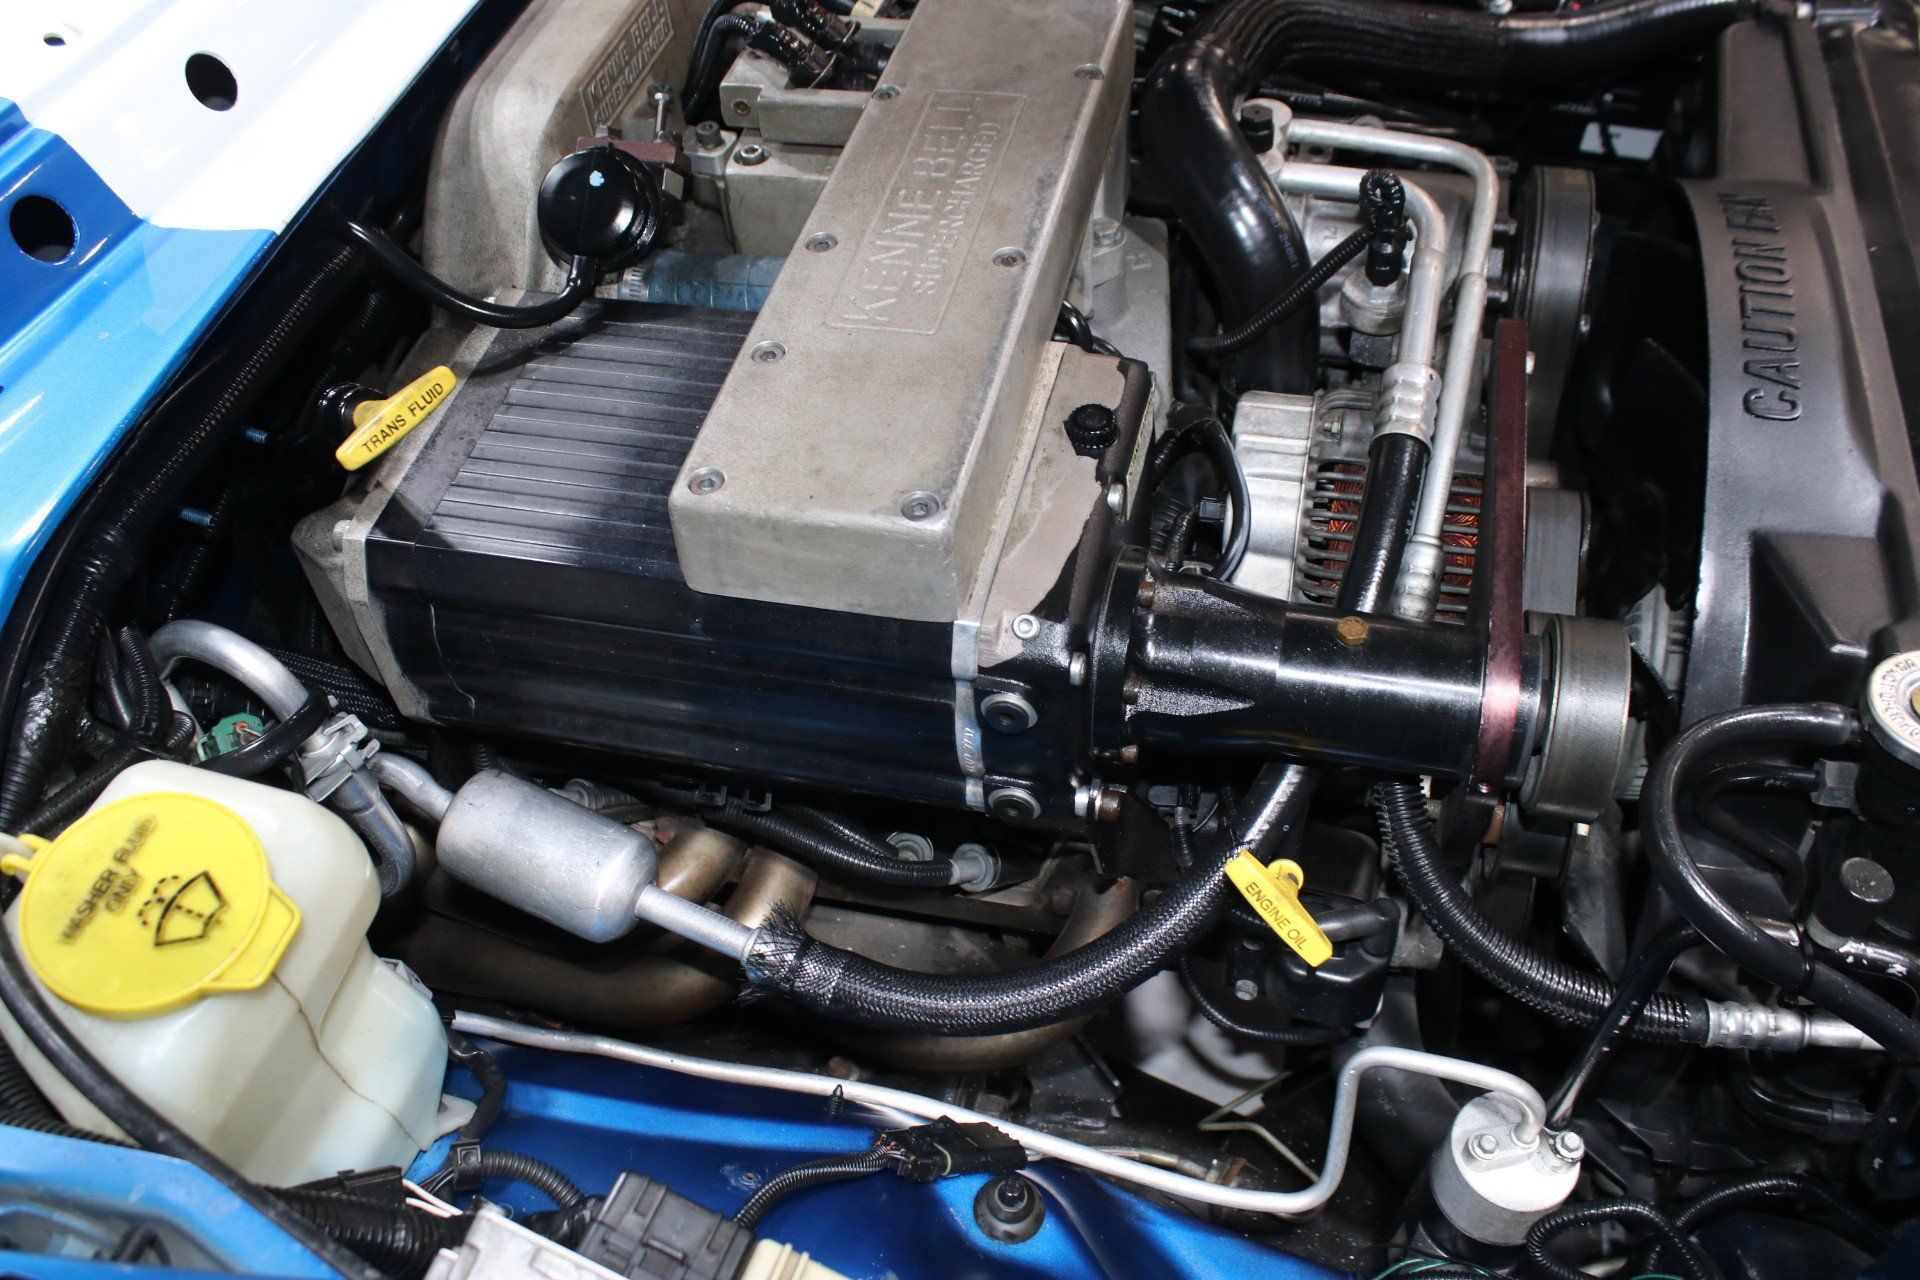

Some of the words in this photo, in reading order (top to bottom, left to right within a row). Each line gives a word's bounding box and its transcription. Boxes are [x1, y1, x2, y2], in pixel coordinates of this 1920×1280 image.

[842, 190, 940, 323] KENNE
[914, 97, 980, 178] BELL
[911, 122, 1002, 295] SUPERCHARGED
[1732, 237, 1802, 422] CAUTION
[361, 414, 407, 453] TRANS
[407, 382, 444, 417] FLUID
[58, 867, 121, 945] WASHER
[112, 814, 158, 866] FLUID
[104, 867, 143, 914] ONLY
[1245, 882, 1291, 930] ENGINE
[1287, 928, 1308, 950] OIL
